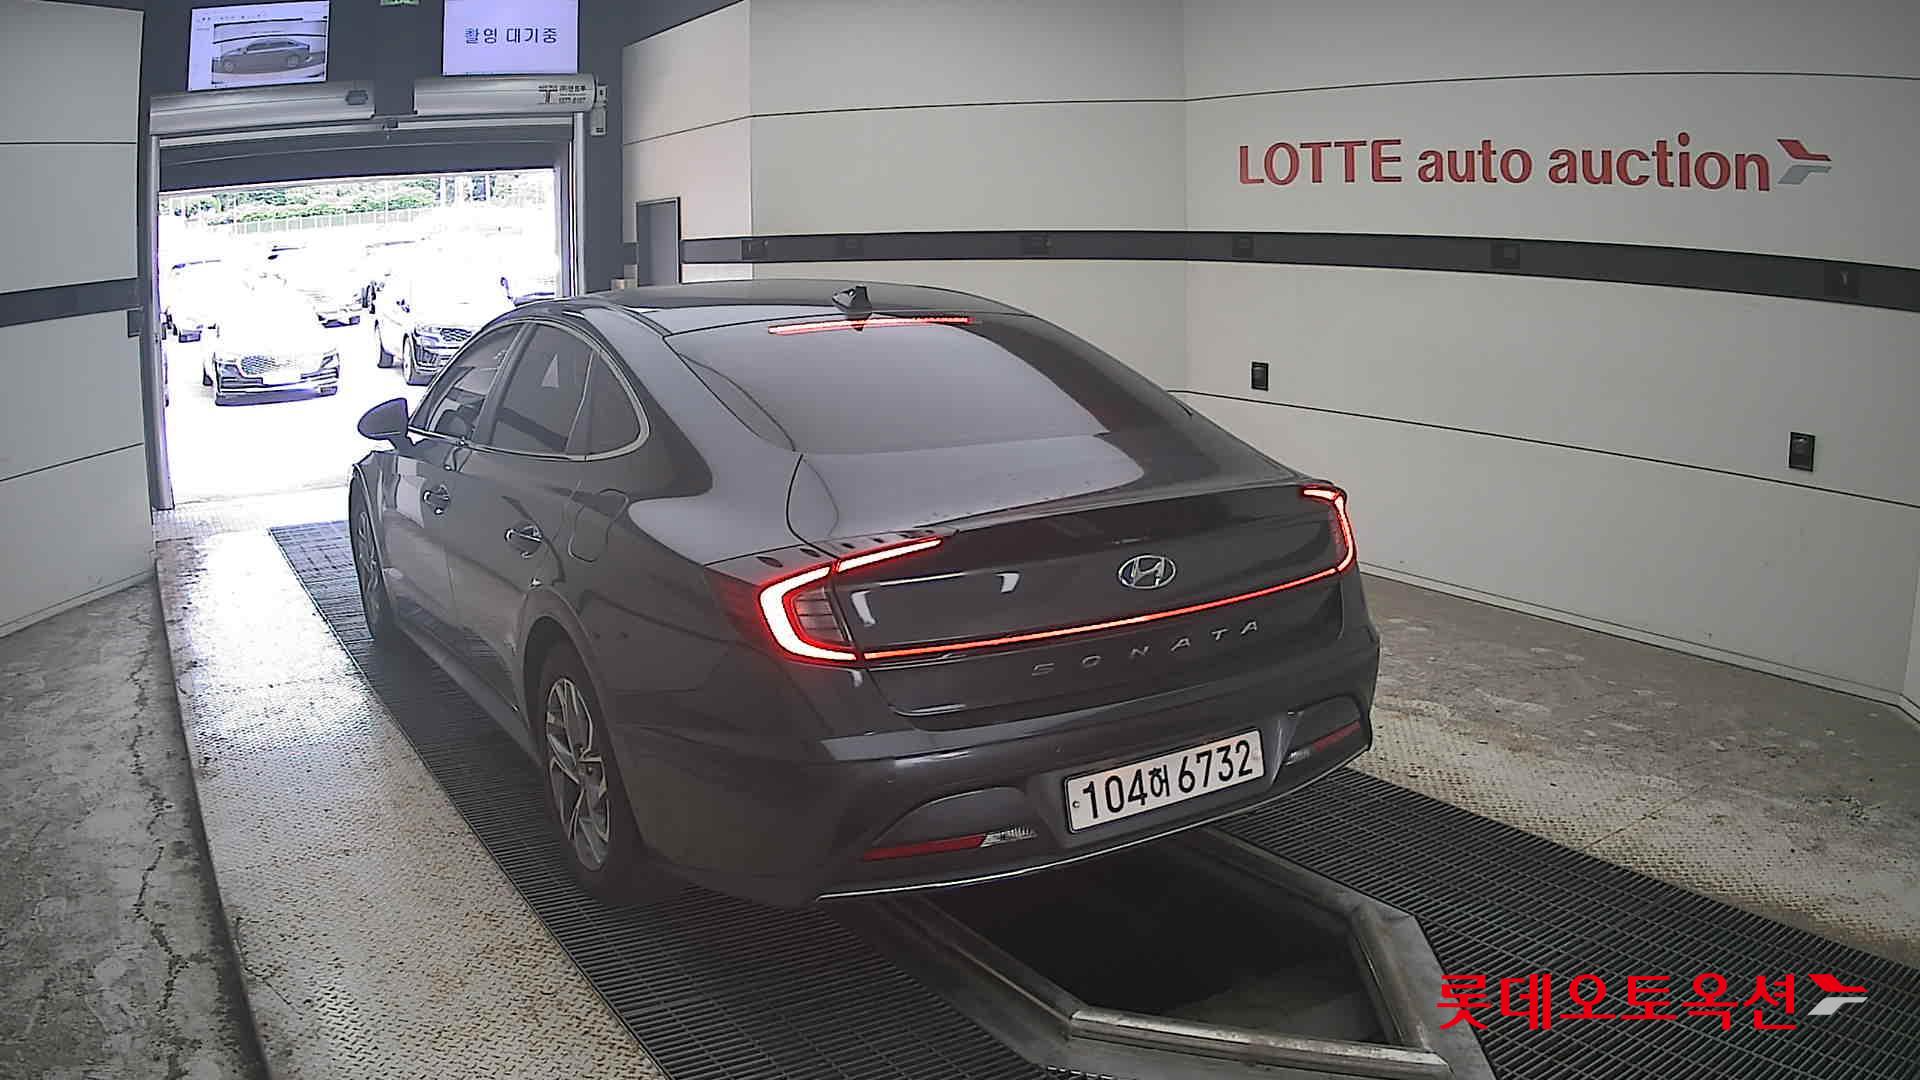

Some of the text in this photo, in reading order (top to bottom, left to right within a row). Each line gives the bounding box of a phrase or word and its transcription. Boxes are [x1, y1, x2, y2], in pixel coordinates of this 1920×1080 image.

[1239, 132, 1771, 192] LOTTE auto auction
[1031, 620, 1258, 677] SONATA
